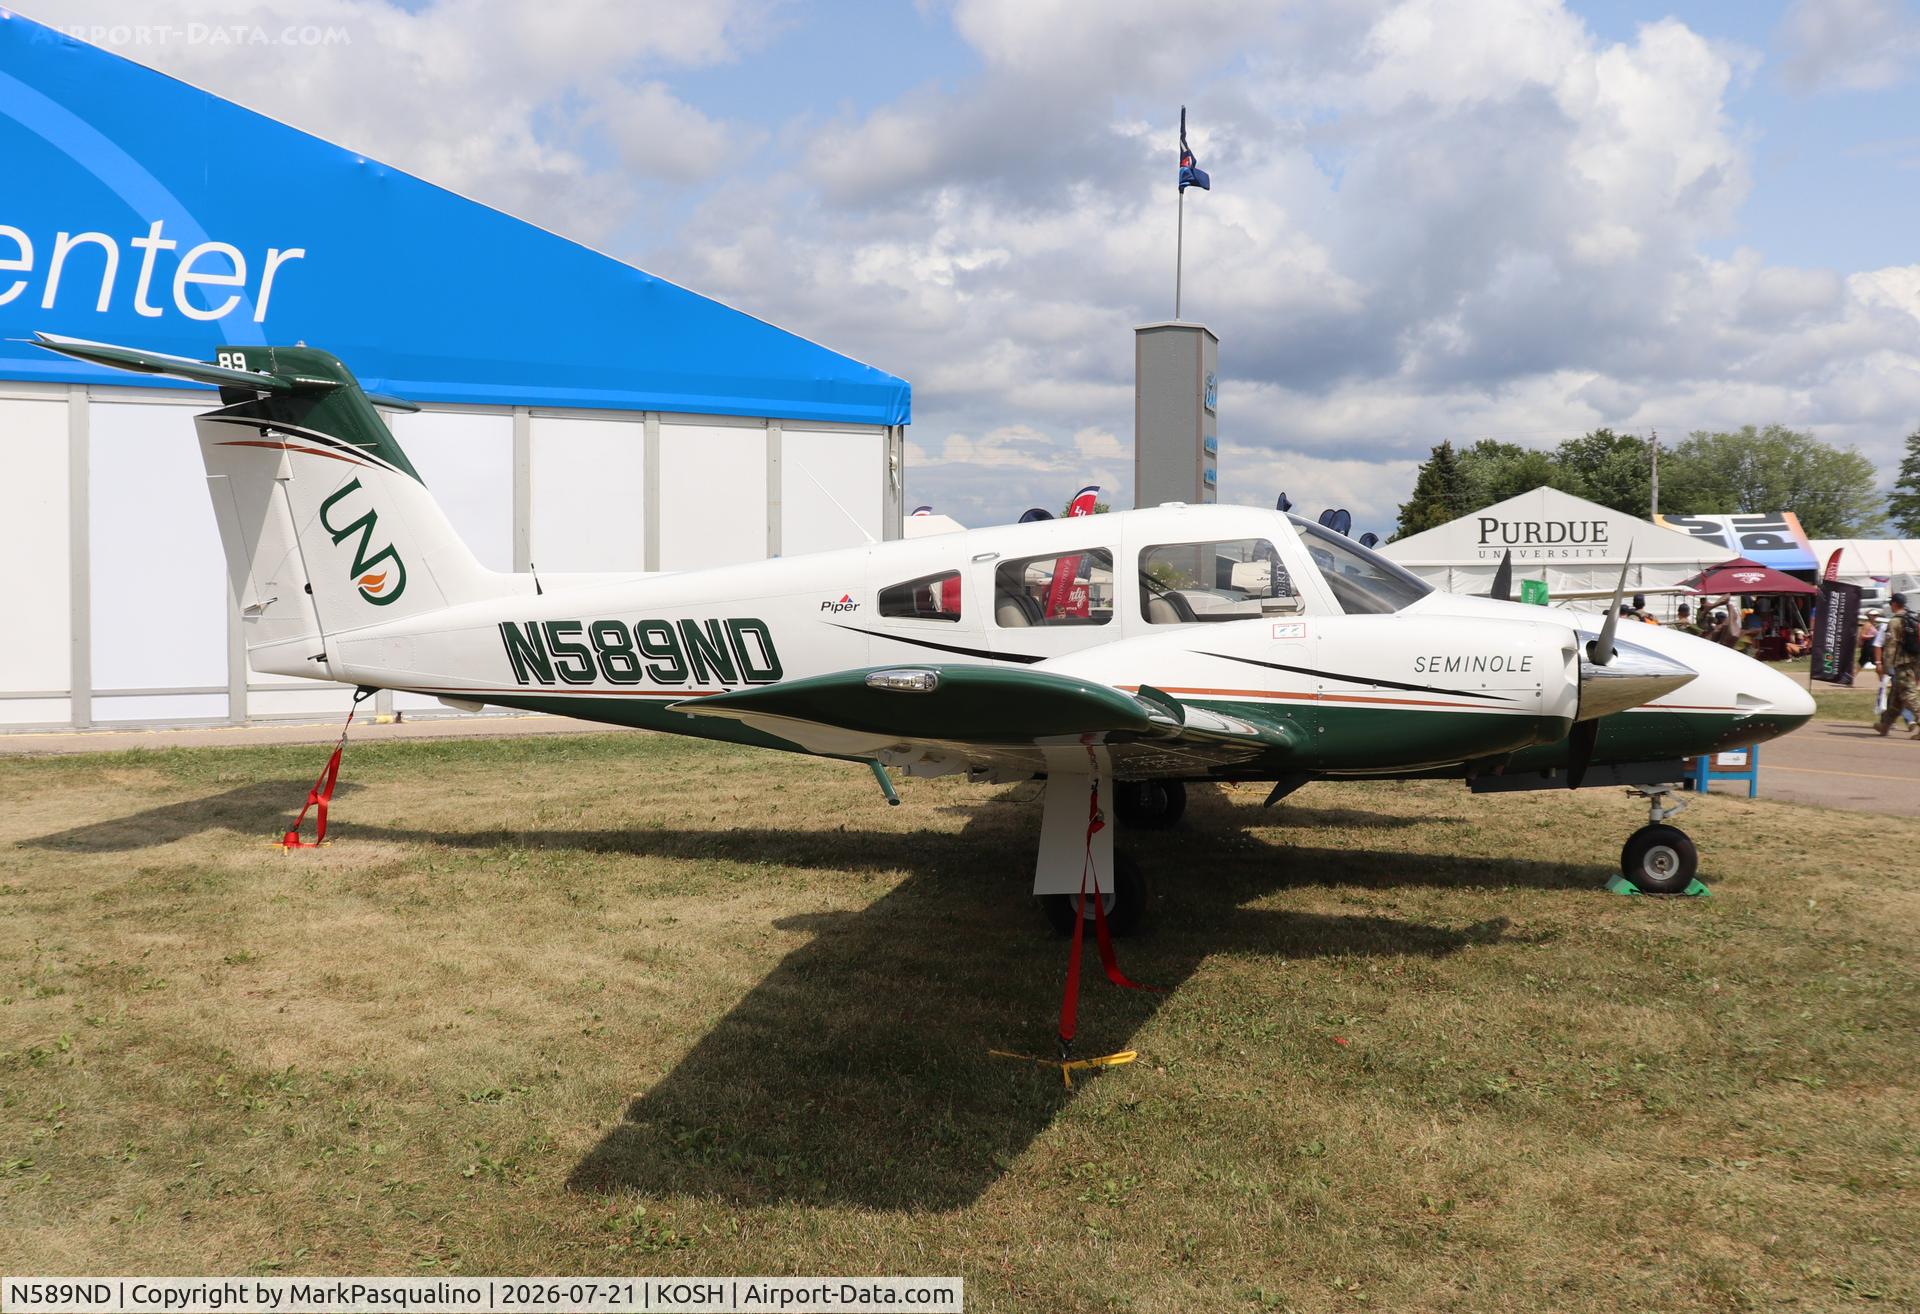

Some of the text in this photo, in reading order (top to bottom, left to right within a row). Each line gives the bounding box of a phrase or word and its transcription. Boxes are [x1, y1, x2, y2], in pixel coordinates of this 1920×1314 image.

[320, 476, 407, 606] UND
[1477, 517, 1608, 544] PURDUE
[820, 601, 860, 614] Piper
[498, 617, 784, 686] N589ND
[1414, 655, 1534, 673] SEMINOLE
